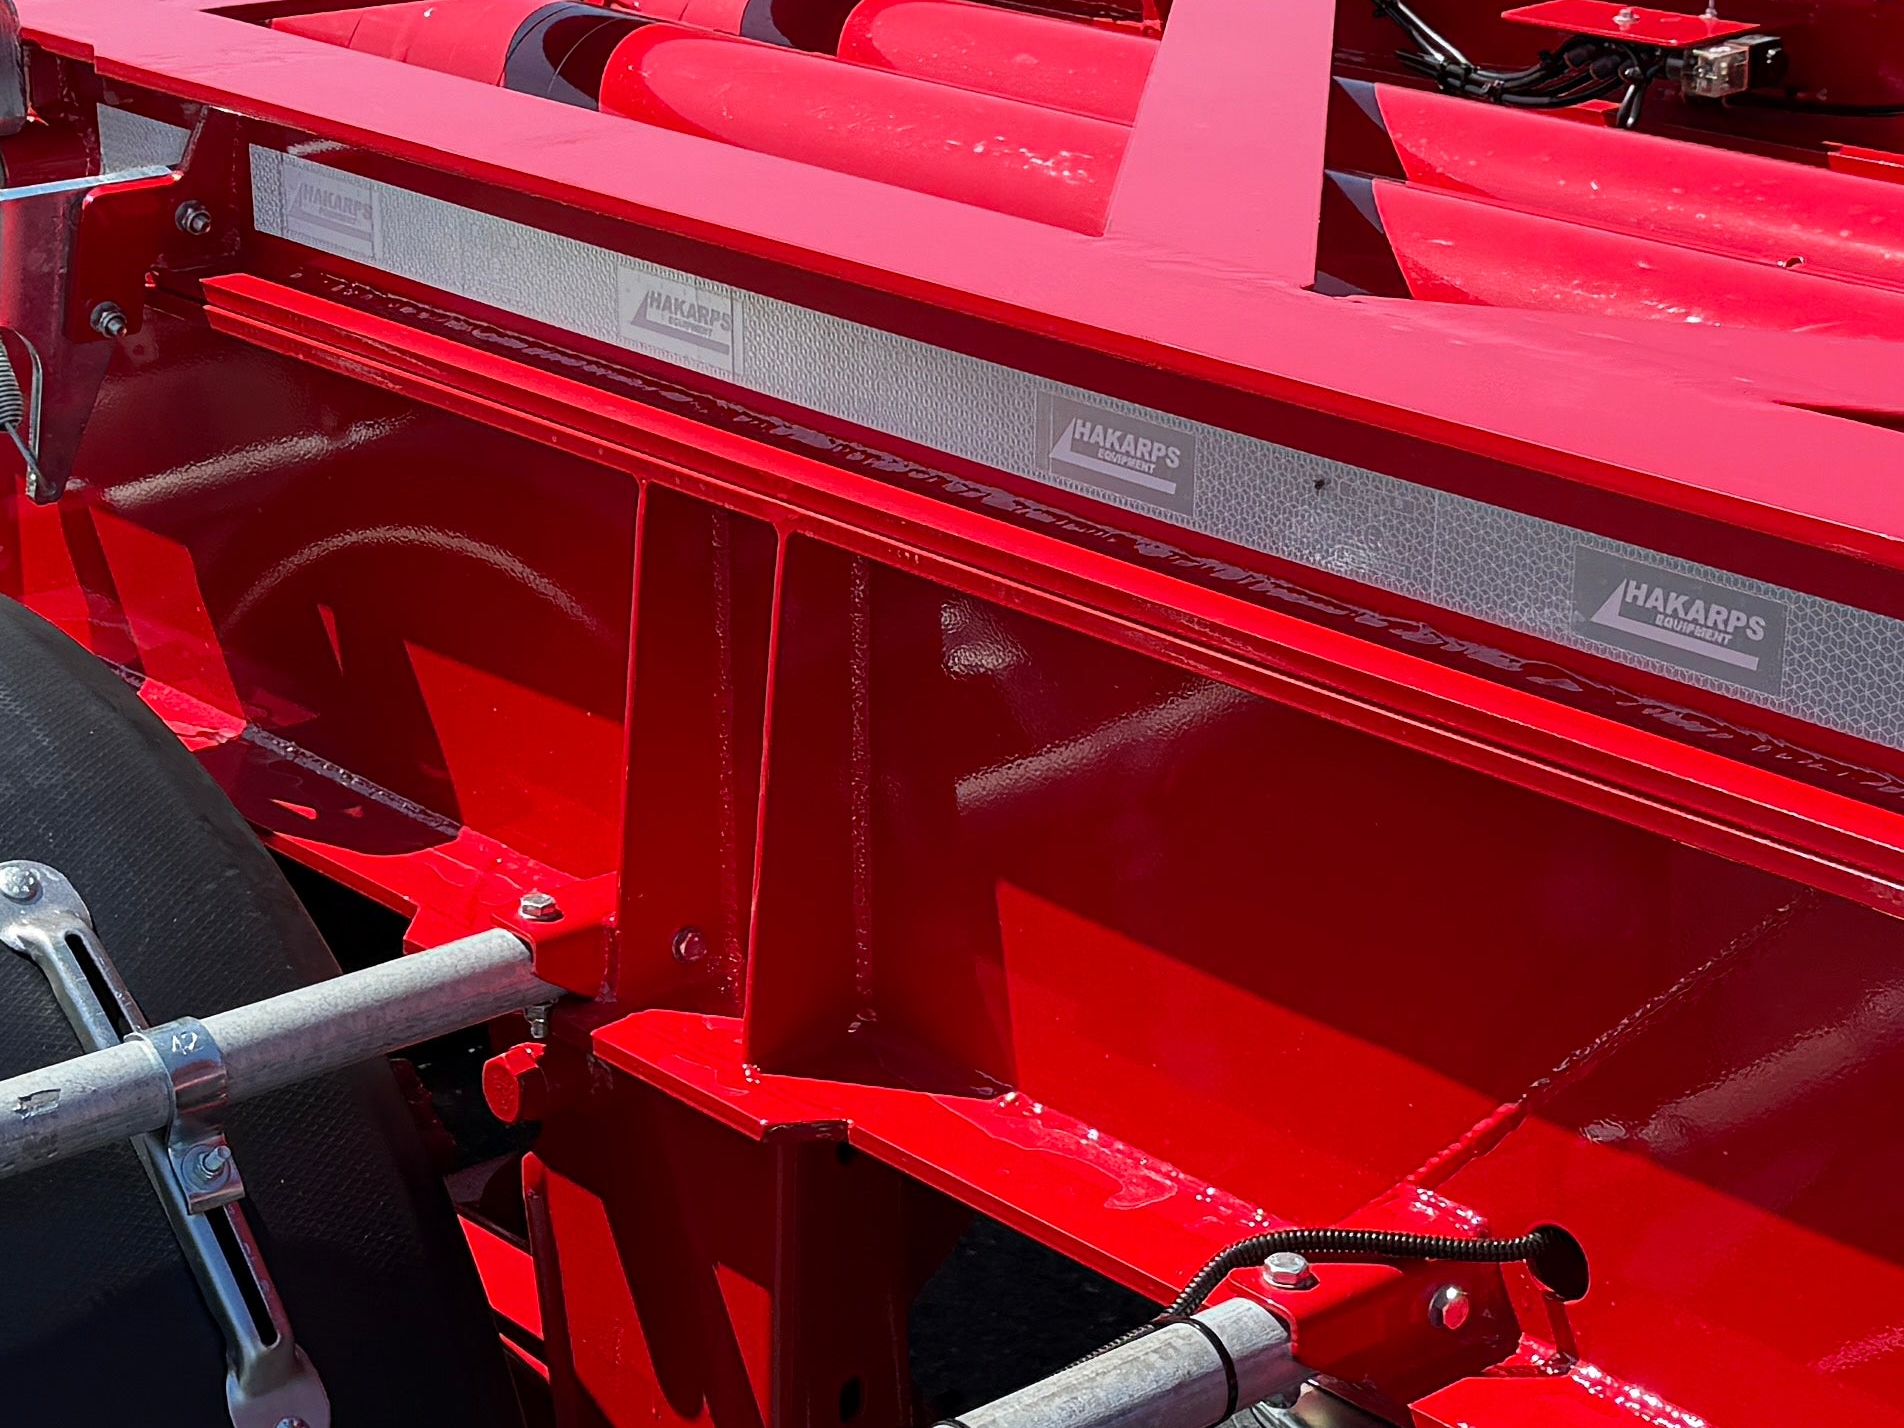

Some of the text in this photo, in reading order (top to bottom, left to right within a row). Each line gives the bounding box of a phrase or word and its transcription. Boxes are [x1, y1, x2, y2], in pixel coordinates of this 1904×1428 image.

[649, 290, 732, 332] HAKARPS
[1074, 419, 1181, 468] HAKARPS
[1097, 448, 1156, 473] EQUIPMENT
[1625, 580, 1766, 641] HAKARPS
[1655, 614, 1733, 646] EQUIPMENT
